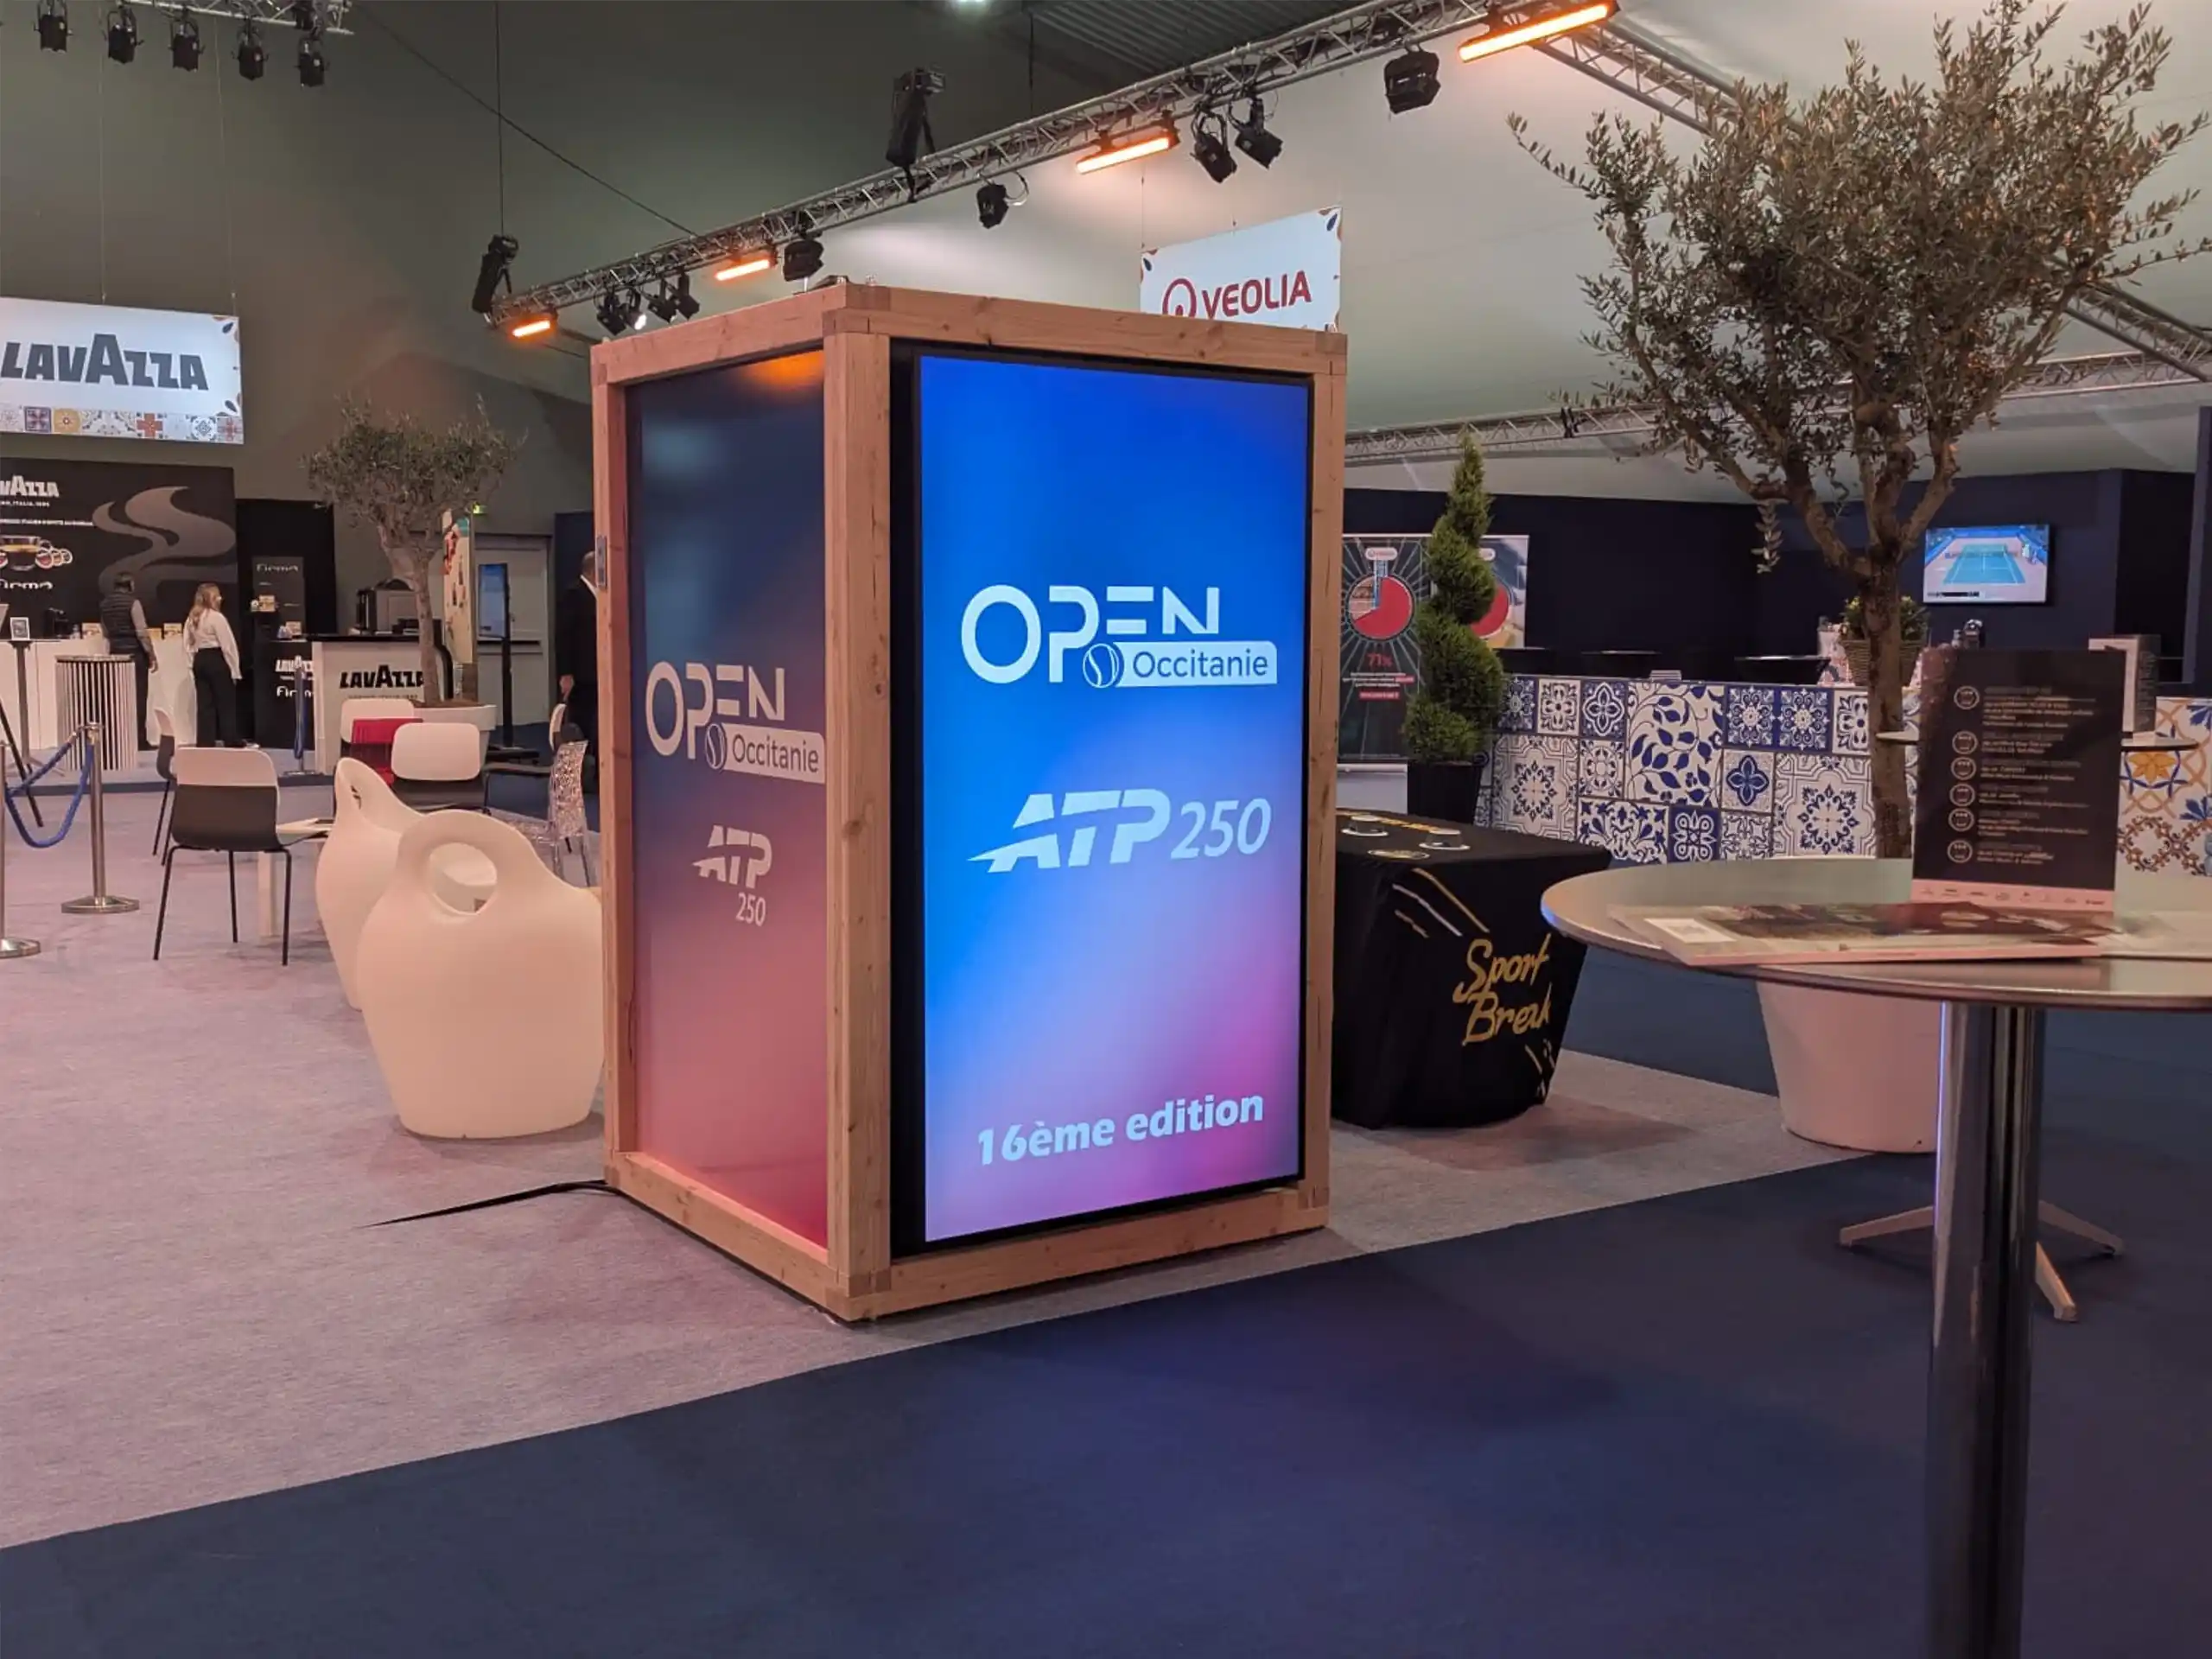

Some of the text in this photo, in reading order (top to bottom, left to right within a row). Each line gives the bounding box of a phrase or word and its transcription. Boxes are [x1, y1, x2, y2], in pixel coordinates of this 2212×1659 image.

[1201, 270, 1312, 320] VEOLIA
[0, 334, 209, 391] LAVAZZA
[961, 584, 1220, 683] OPEN
[1133, 648, 1269, 679] Occitanie
[645, 661, 785, 760] OPEN
[733, 734, 819, 772] Occitanie
[692, 824, 772, 889] ATP
[967, 788, 1273, 873] ATP 250
[736, 892, 766, 926] 250
[1452, 932, 1552, 1004] Sport
[977, 1094, 1264, 1166] 16ème edition
